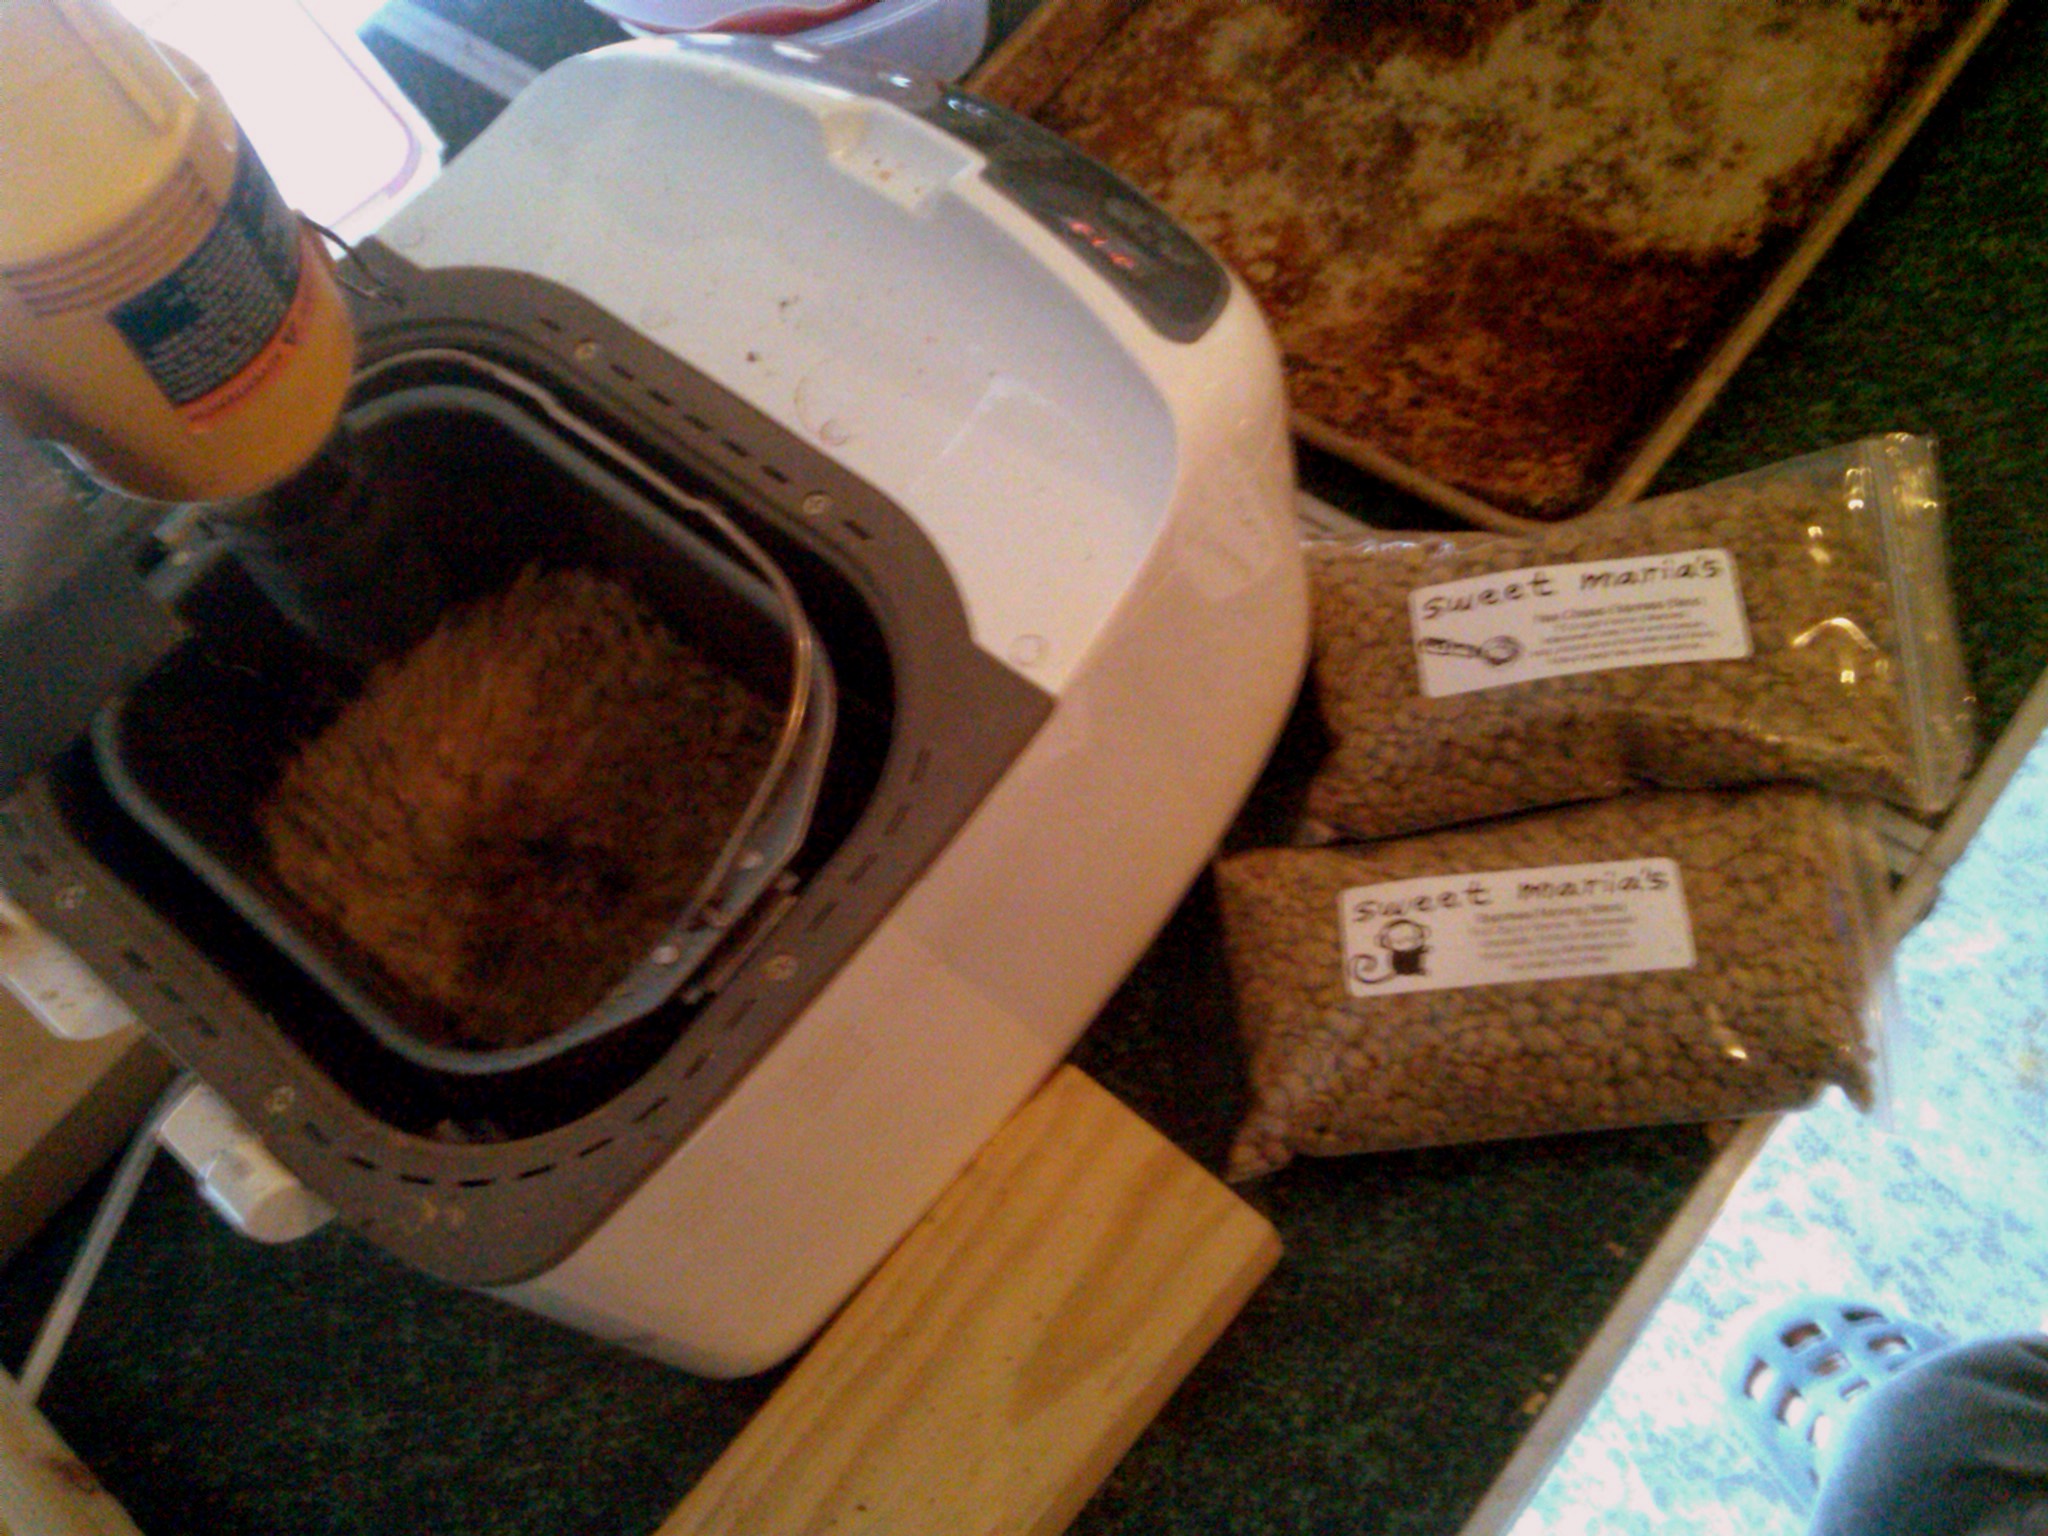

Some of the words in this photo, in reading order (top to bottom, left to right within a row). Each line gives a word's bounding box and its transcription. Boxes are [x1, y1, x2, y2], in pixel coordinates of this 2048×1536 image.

[1422, 572, 1556, 619] sweet
[1580, 557, 1722, 590] maria's
[1353, 883, 1492, 922] sweet
[1516, 868, 1669, 901] maria's
